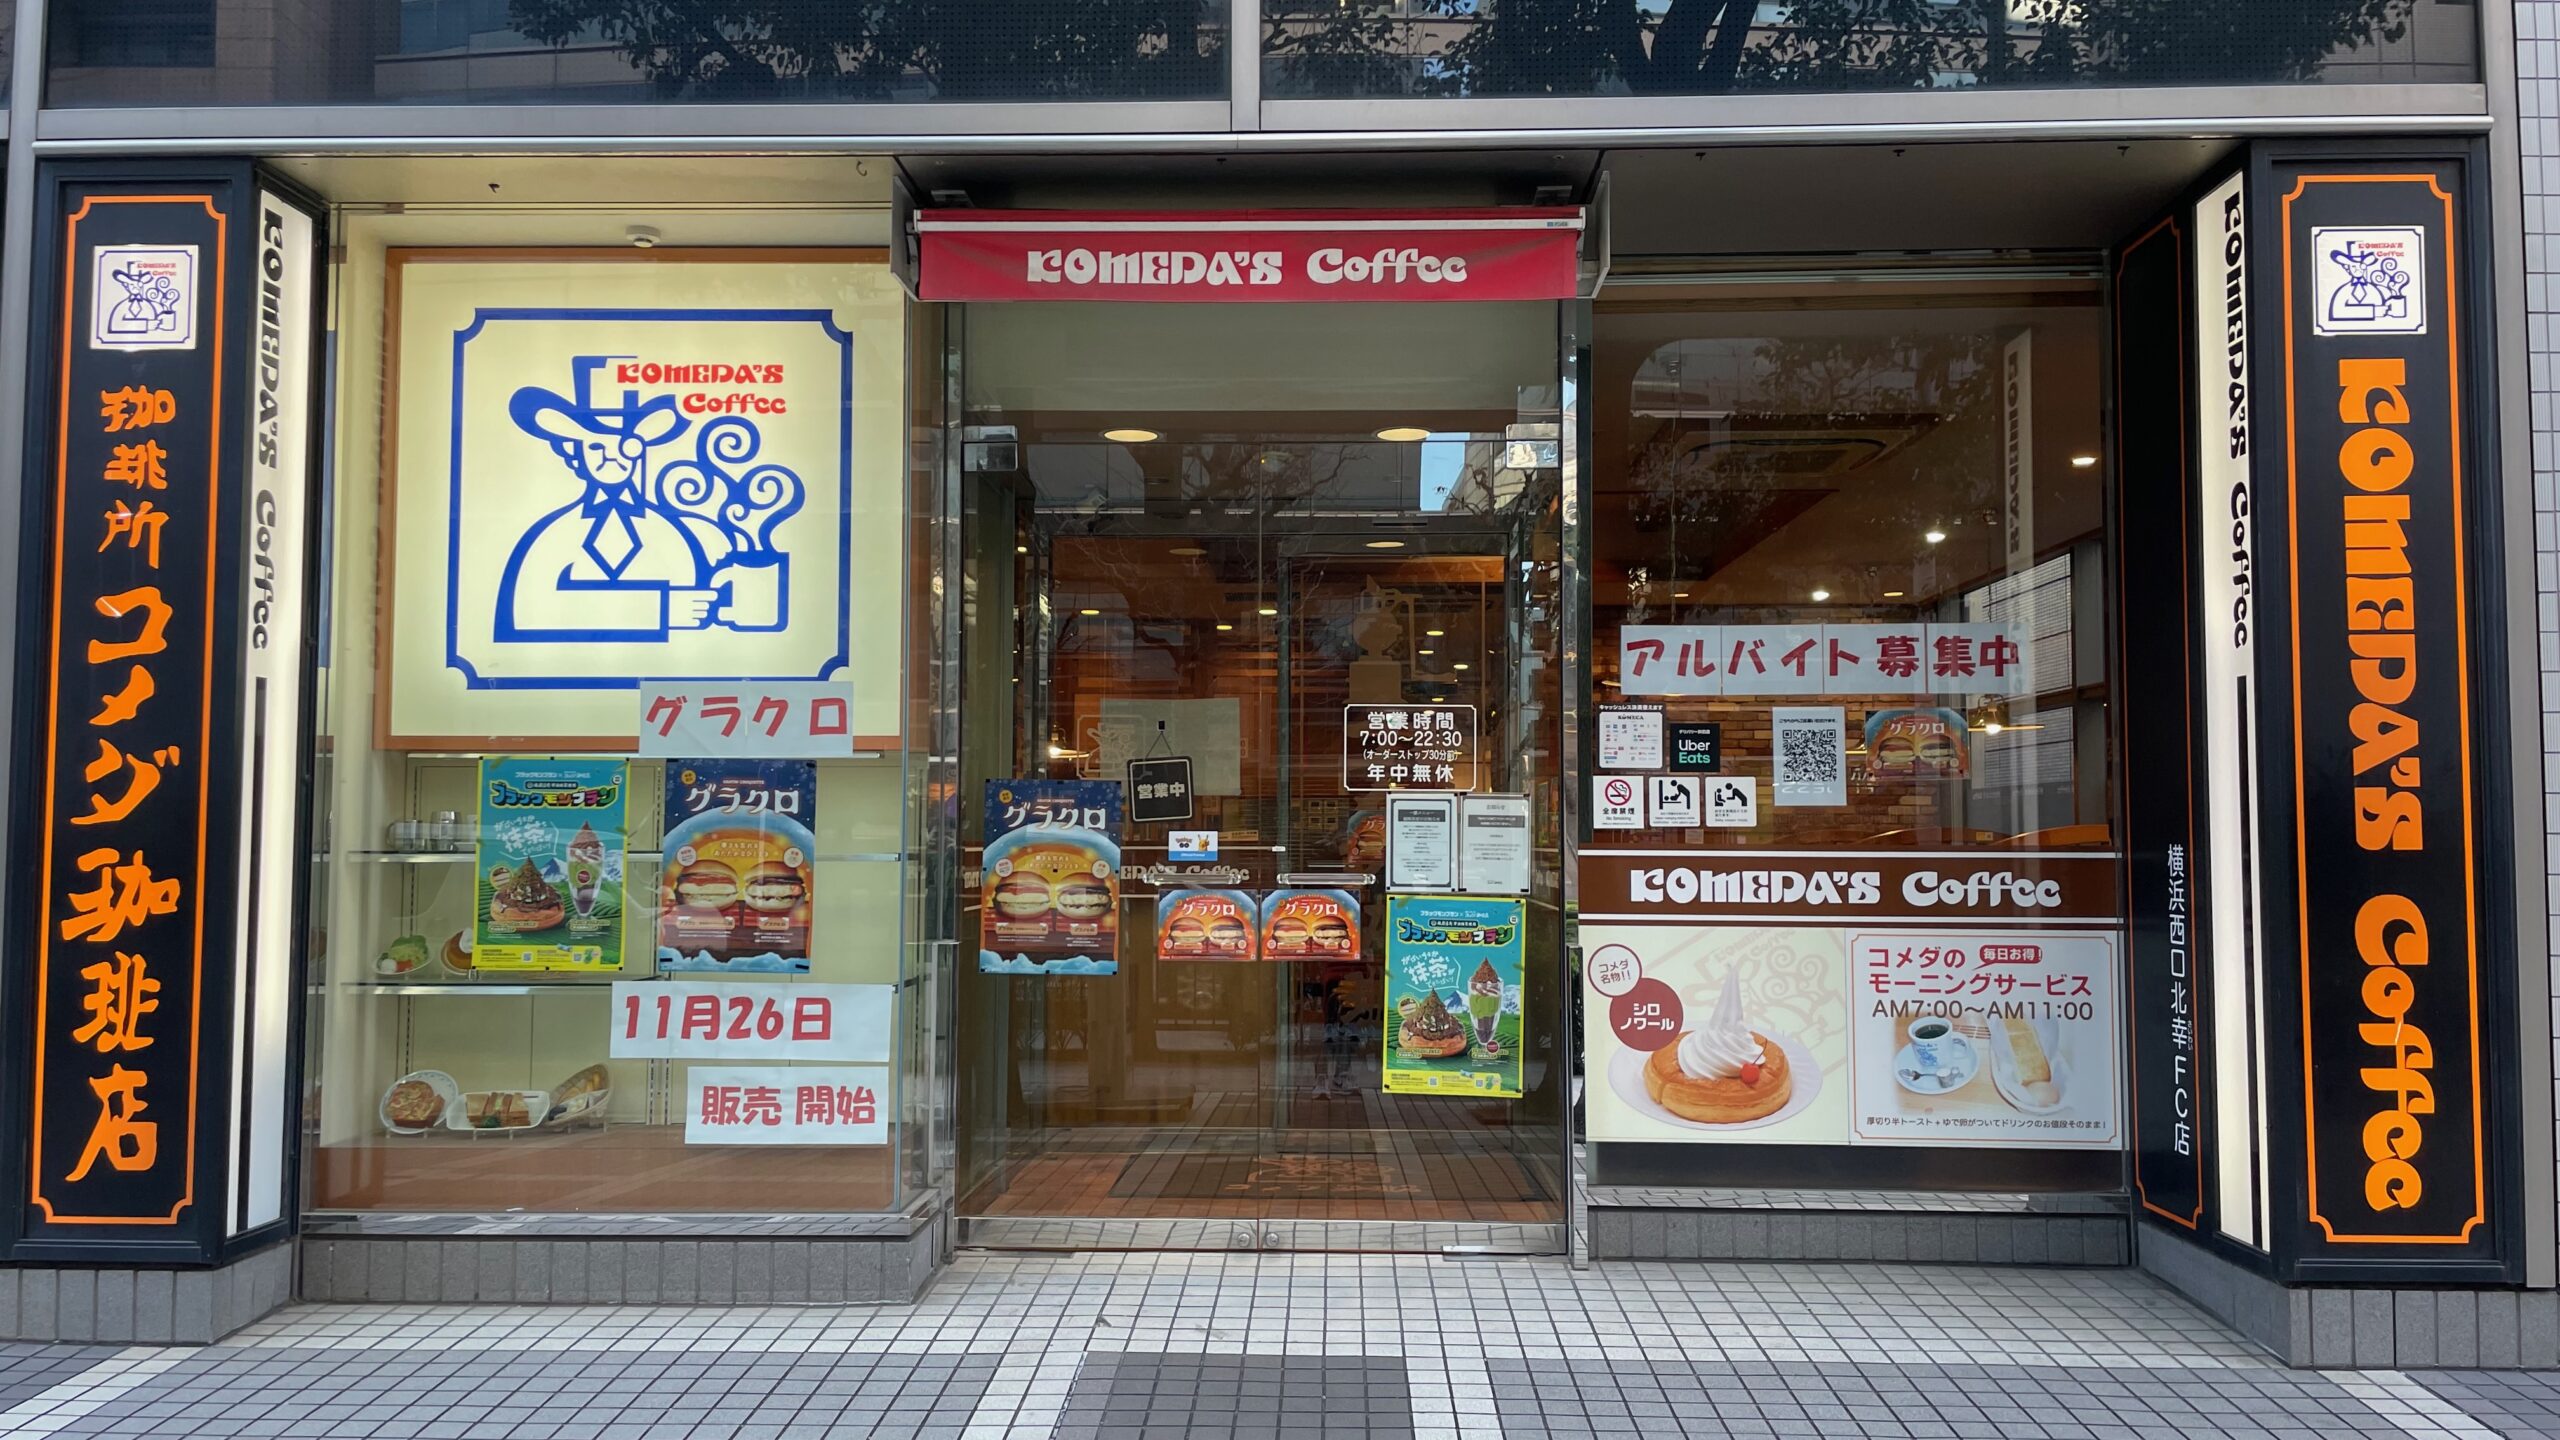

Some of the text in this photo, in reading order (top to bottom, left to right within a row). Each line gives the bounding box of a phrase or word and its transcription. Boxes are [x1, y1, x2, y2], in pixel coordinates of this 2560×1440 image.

[1027, 248, 1469, 286] KOMEDA'S Coffee
[616, 363, 785, 385] KOMEDA'S
[682, 393, 787, 415] Coffee
[252, 207, 283, 651] KOMEDA'S Coffee
[2224, 191, 2251, 650] KOMEDA'S Coffee
[1626, 635, 2019, 678] アルバイト募集中
[646, 695, 848, 738] グラクロ
[1368, 711, 1454, 730] 営業時間
[1679, 739, 1711, 751] Uber
[1679, 752, 1711, 764] Eats
[1367, 763, 1454, 783] 年中無休
[1137, 782, 1185, 800] 営業中
[2339, 358, 2436, 1212] KOMEDA'S Coffee
[685, 783, 799, 815] グラクロ
[1003, 801, 1106, 829] グラクロ
[1630, 868, 2062, 907] KOMEDA'S Coffee
[1182, 902, 1235, 916] グラクロ
[1285, 902, 1338, 916] グラクロ
[1599, 959, 1629, 973] コメダ
[1869, 946, 1966, 969] コメダの
[1869, 973, 2093, 997] モーニングサービス
[625, 994, 832, 1042] 11月26日
[1633, 1003, 1660, 1016] シロ
[1620, 1018, 1675, 1032] ノワール
[701, 1085, 876, 1126] 販売 開始
